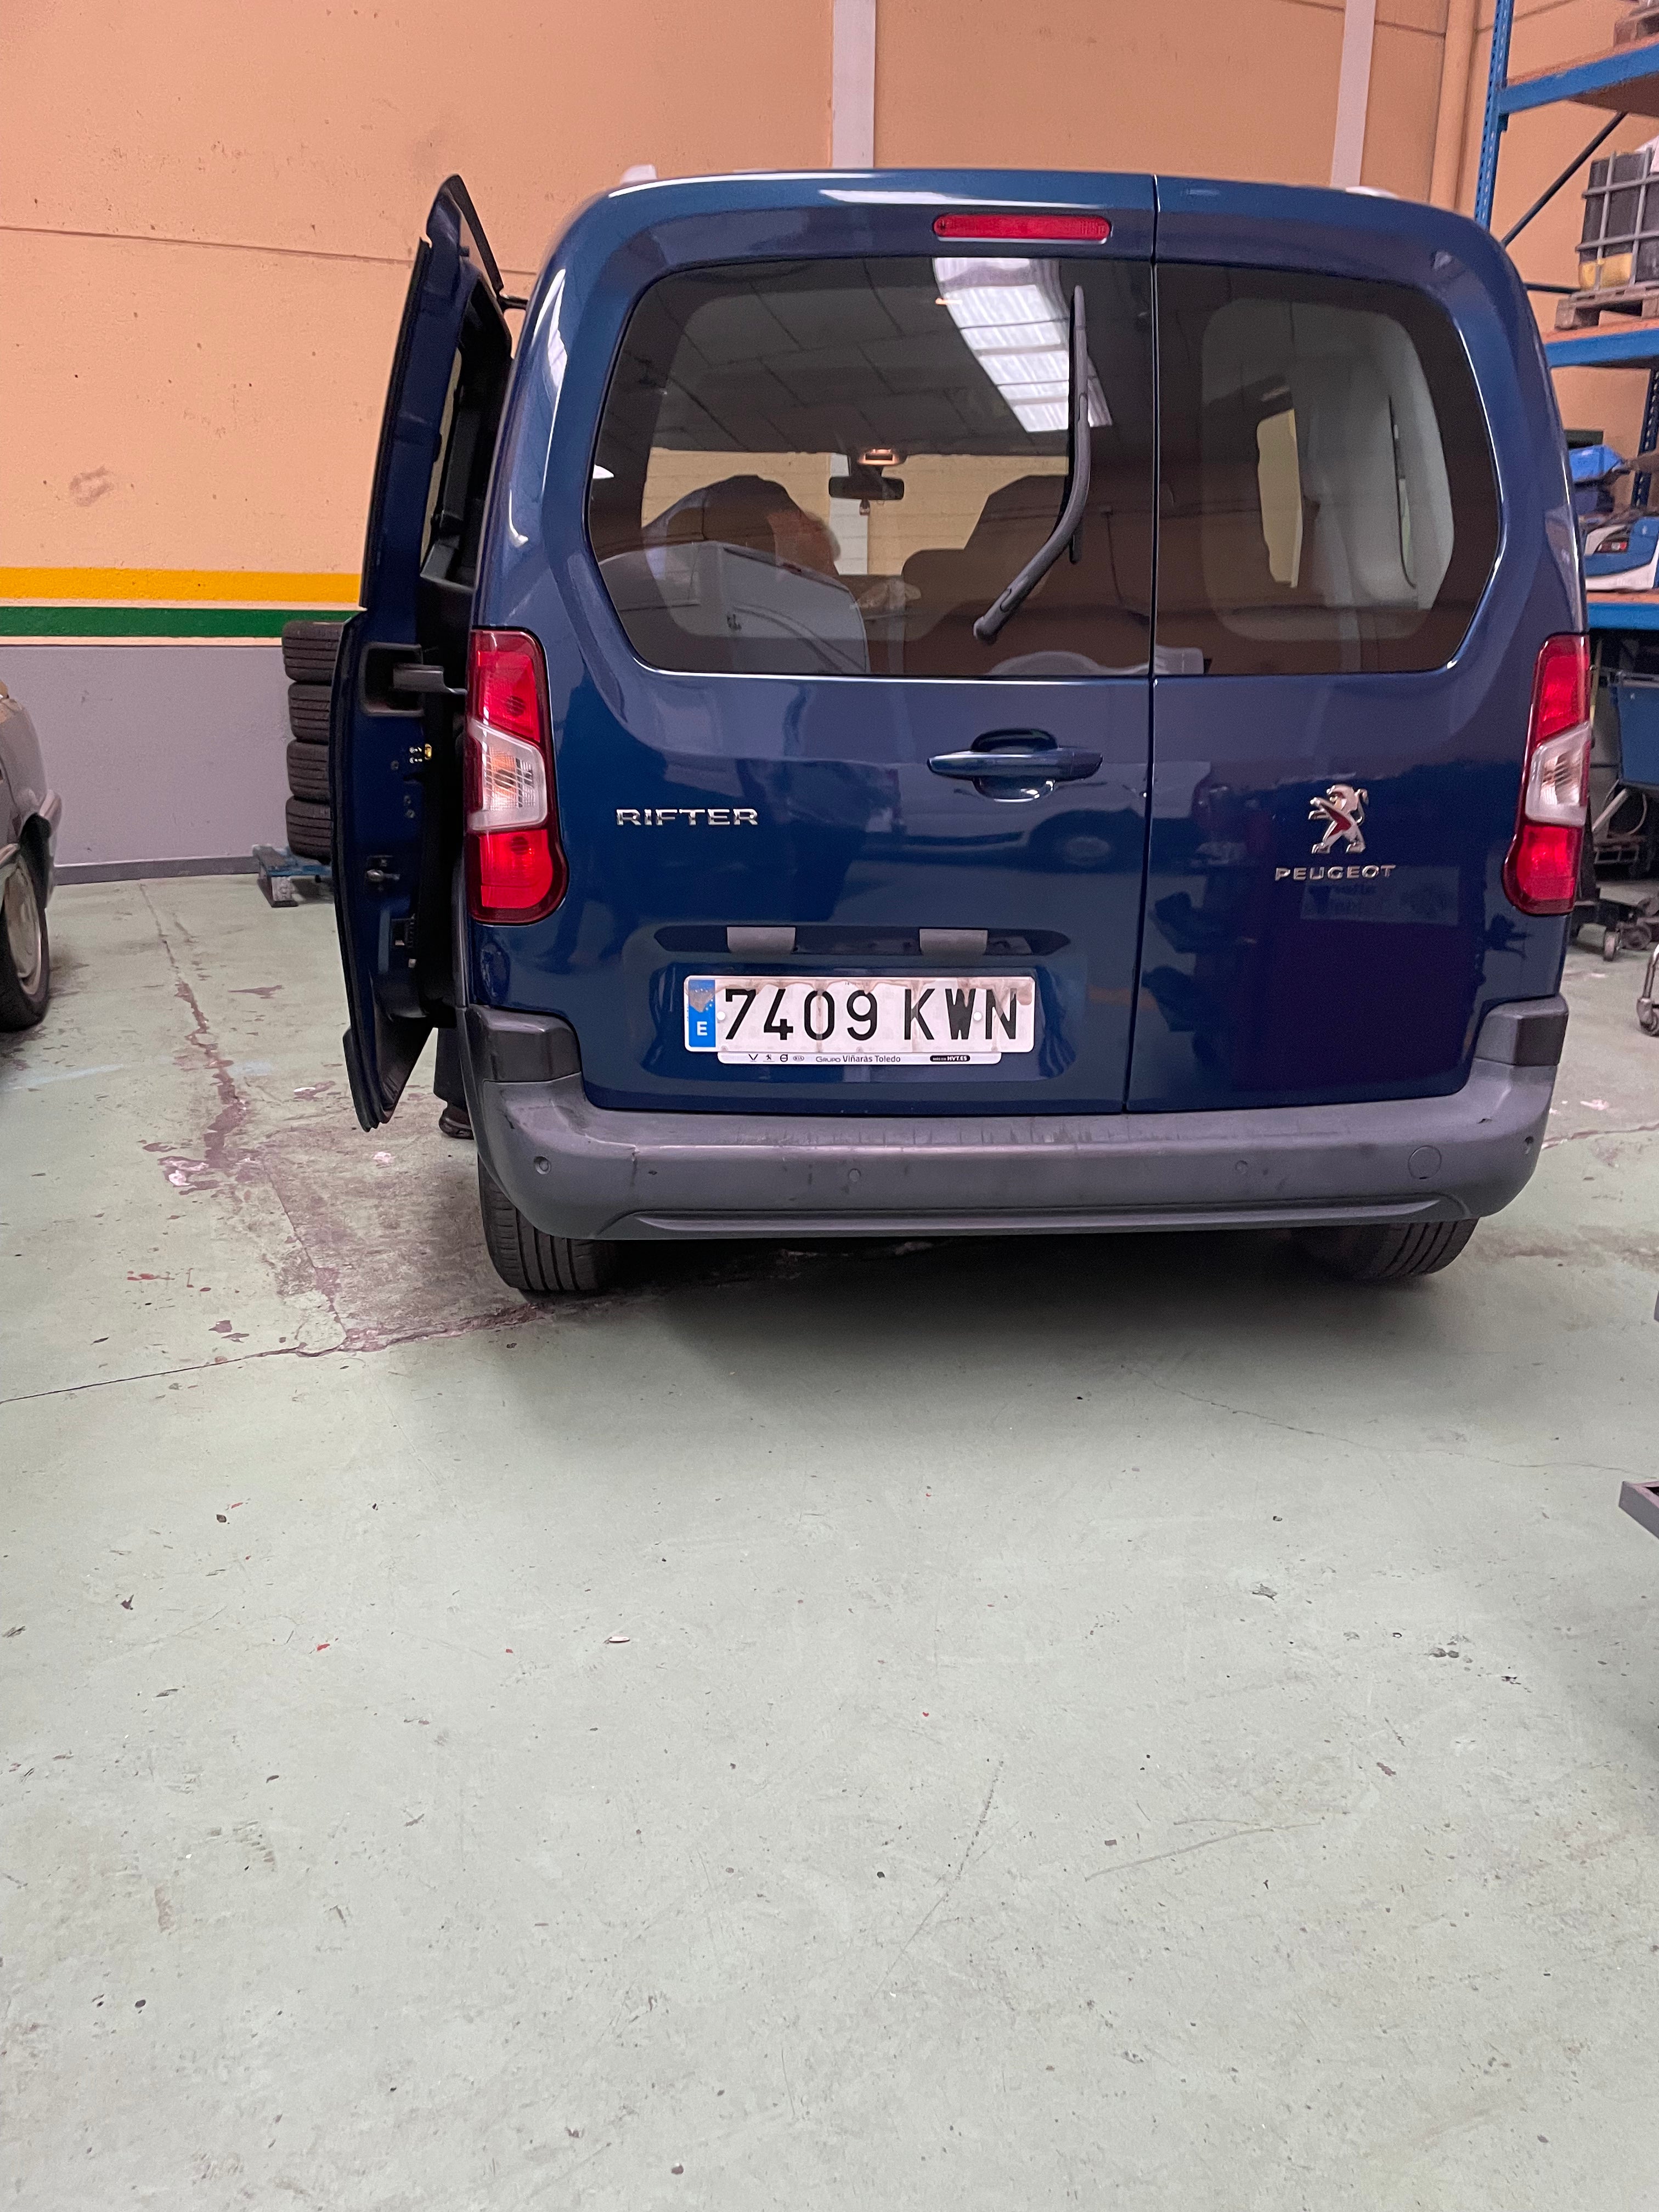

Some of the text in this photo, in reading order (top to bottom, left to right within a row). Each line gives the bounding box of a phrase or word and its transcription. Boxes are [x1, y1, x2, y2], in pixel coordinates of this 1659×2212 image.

[616, 808, 758, 826] RIFTER
[1274, 864, 1396, 881] PEUGEOT
[724, 988, 1017, 1041] 7409 KWN
[696, 1021, 708, 1036] E
